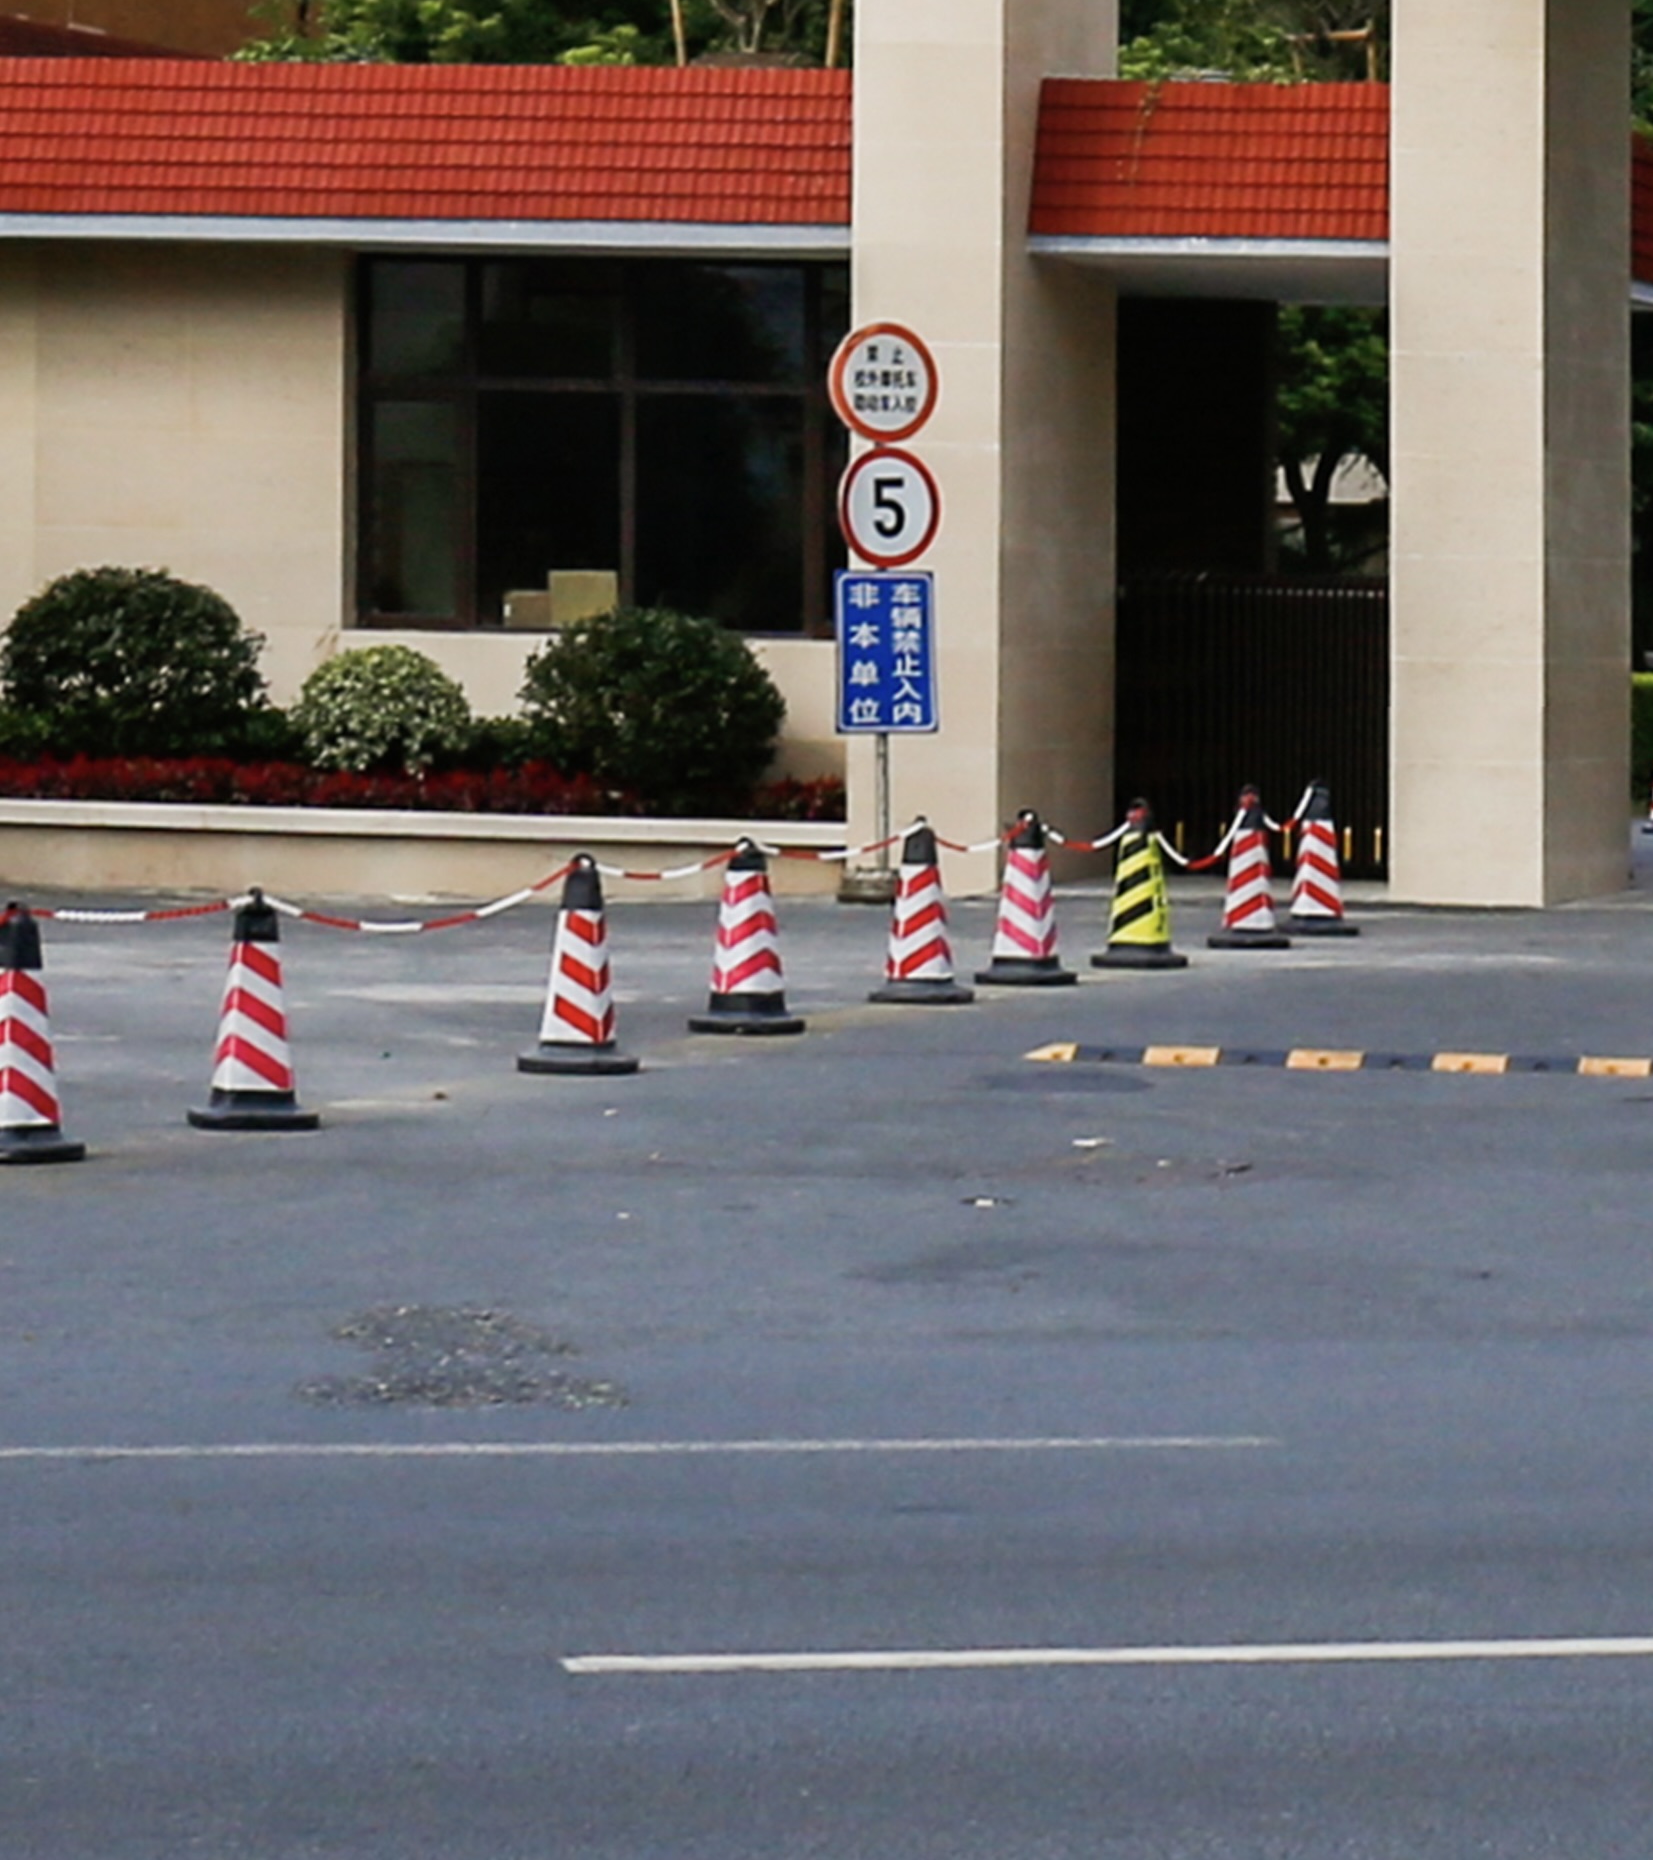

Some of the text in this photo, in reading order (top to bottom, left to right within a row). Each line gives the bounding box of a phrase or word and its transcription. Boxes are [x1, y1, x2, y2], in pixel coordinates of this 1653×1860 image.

[873, 477, 906, 538] 5
[848, 582, 881, 724] 非本单位
[890, 582, 923, 725] 车辆禁止入内
